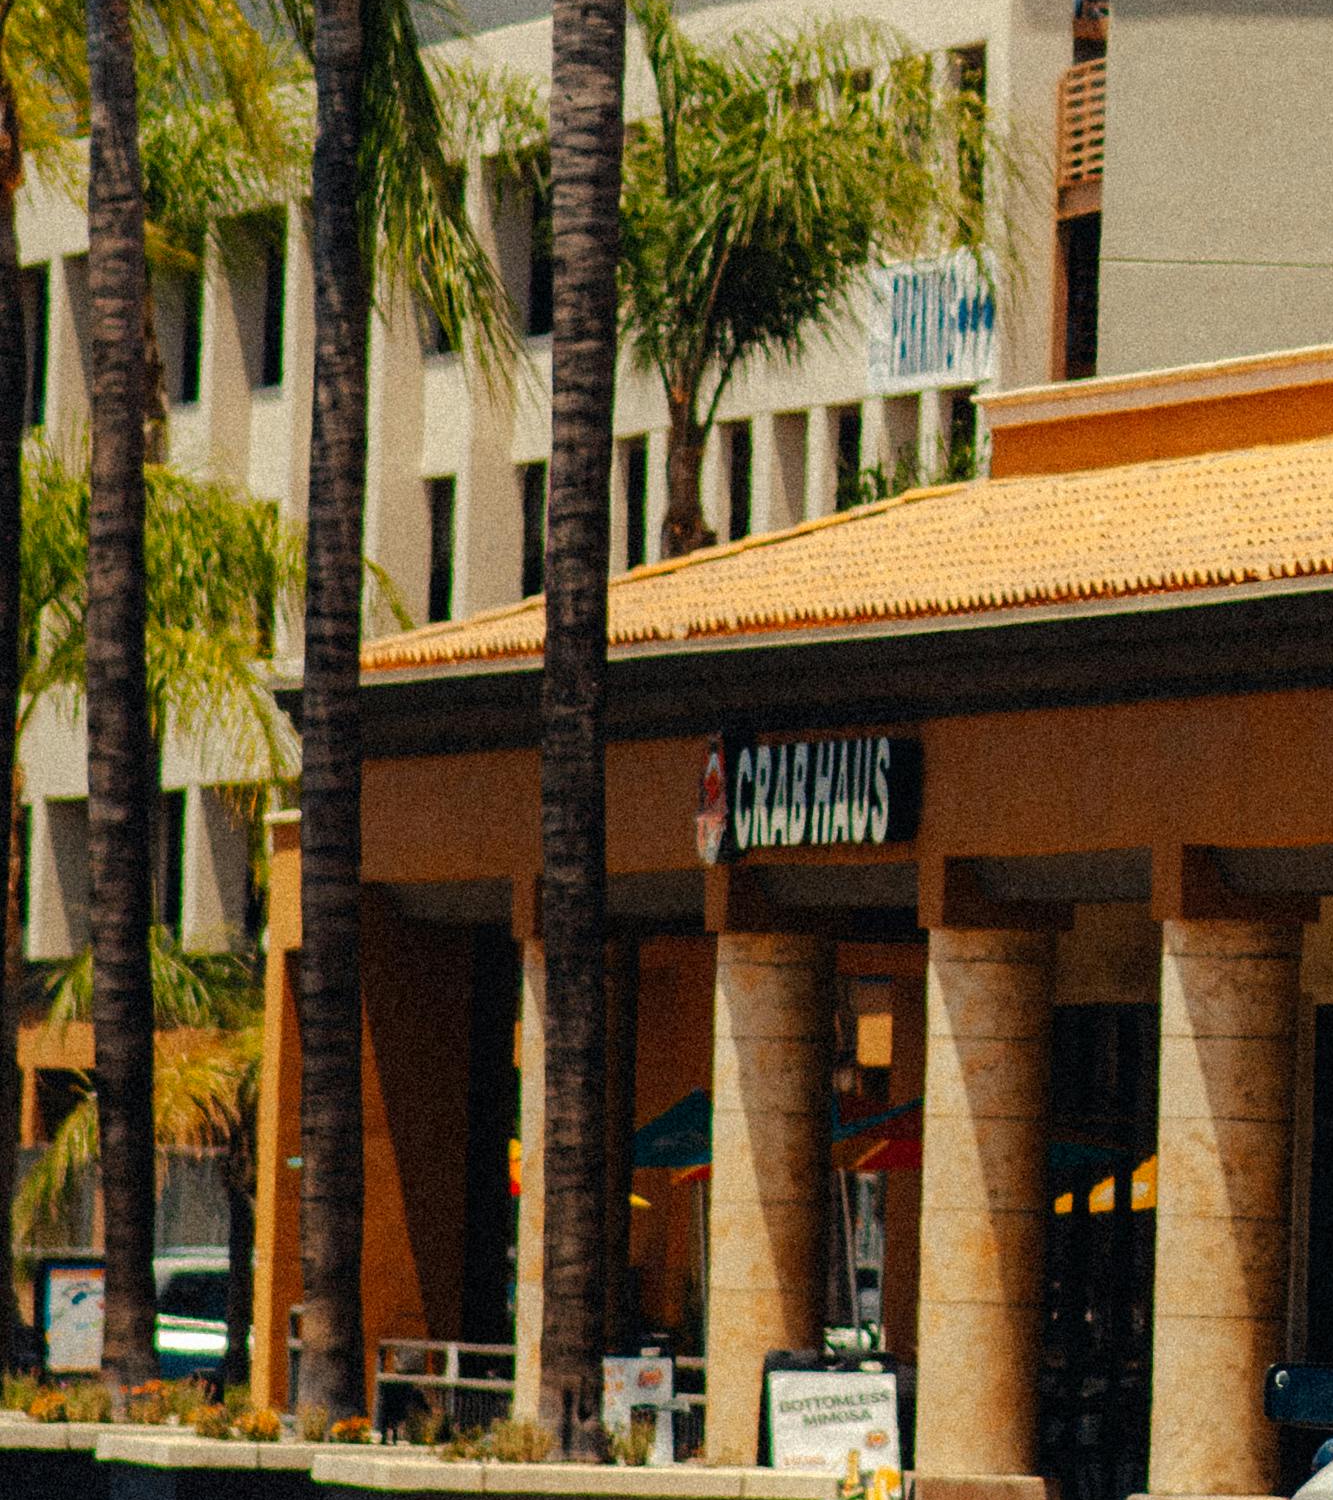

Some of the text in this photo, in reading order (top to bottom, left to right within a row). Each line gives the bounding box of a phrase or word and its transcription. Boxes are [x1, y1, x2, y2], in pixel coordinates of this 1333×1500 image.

[735, 742, 808, 850] CRAB
[811, 736, 890, 845] HAUS
[780, 1388, 891, 1413] BOTTOMLESS
[802, 1408, 873, 1427] MIMOSA
